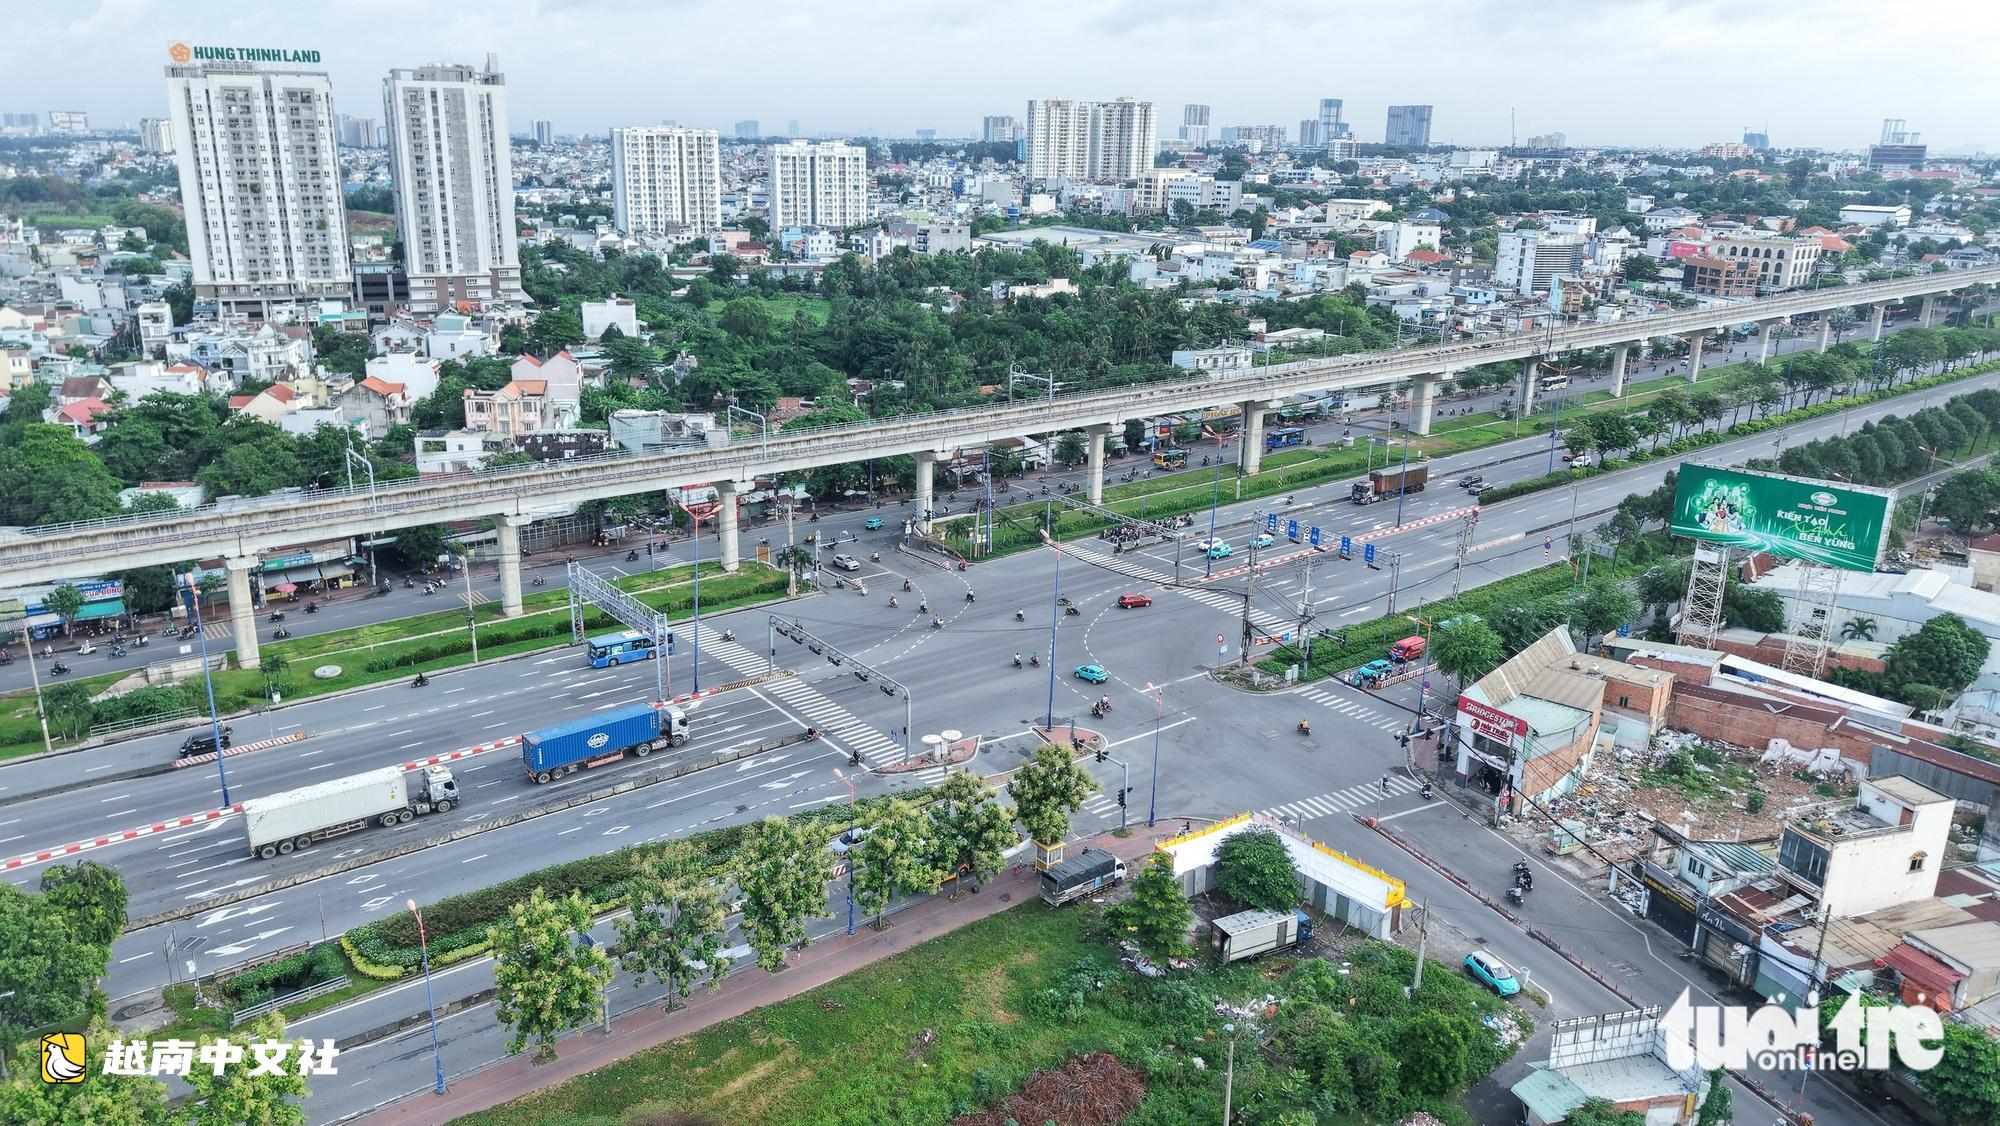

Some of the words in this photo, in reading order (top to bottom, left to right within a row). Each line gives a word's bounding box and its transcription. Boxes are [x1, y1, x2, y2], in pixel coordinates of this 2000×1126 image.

[194, 46, 236, 61] HUNG
[235, 48, 281, 62] THINH
[283, 49, 321, 63] LAND
